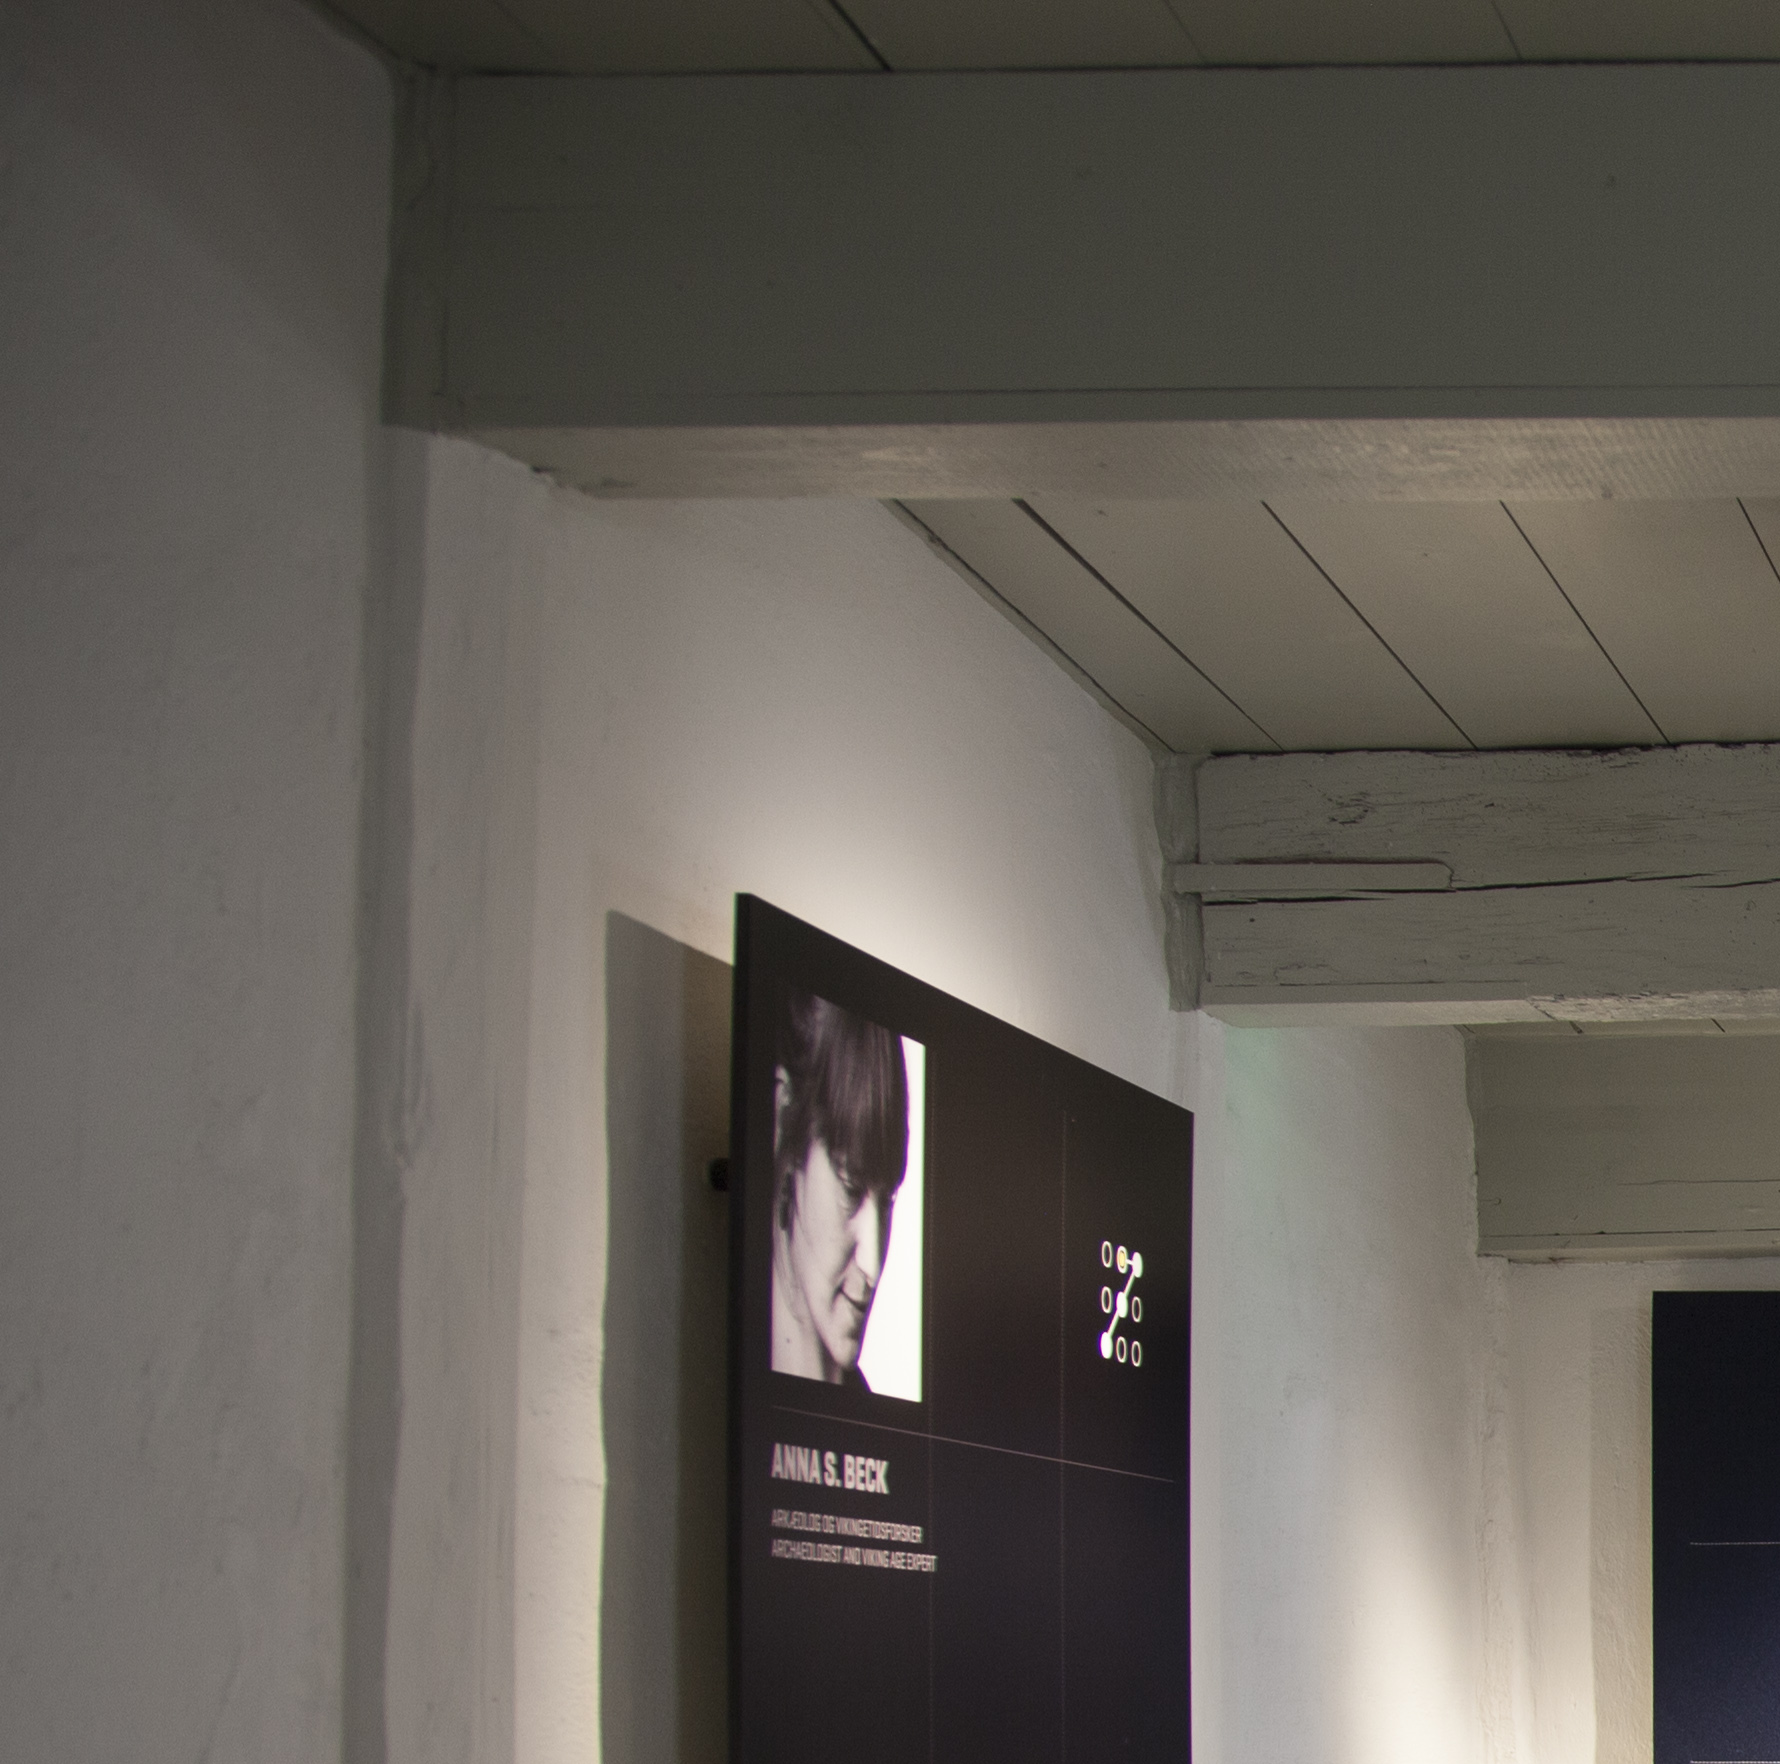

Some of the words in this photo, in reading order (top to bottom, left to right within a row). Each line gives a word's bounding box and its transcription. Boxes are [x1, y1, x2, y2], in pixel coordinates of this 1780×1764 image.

[771, 1442, 822, 1485] ANNA
[823, 1451, 843, 1489] S.
[843, 1453, 890, 1494] BECK
[771, 1509, 821, 1532] ARKÆOLOG
[822, 1515, 836, 1534] OG
[836, 1516, 923, 1543] VIKINGETIDSFORSKER
[771, 1539, 842, 1564] ARCHAEOLOGIST
[843, 1548, 861, 1566] AND
[861, 1548, 890, 1568] VIKING
[890, 1551, 906, 1570] AGE
[907, 1554, 938, 1573] EXPERT
